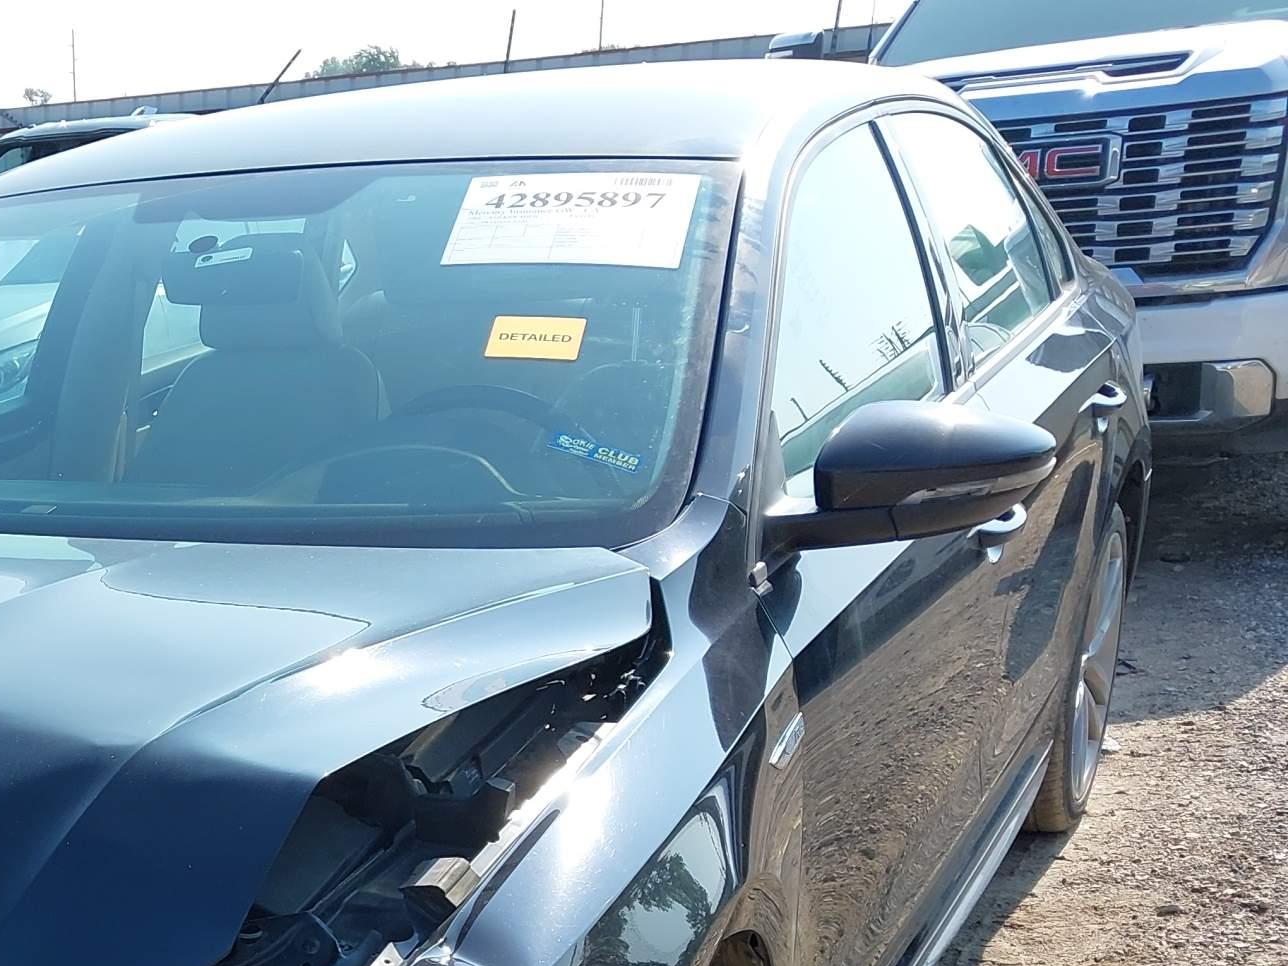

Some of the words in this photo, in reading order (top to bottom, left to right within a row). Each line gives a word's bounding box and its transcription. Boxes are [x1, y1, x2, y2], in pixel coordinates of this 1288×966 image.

[484, 191, 667, 209] 42895897
[498, 331, 573, 343] DETAILED
[598, 446, 640, 466] CLUB
